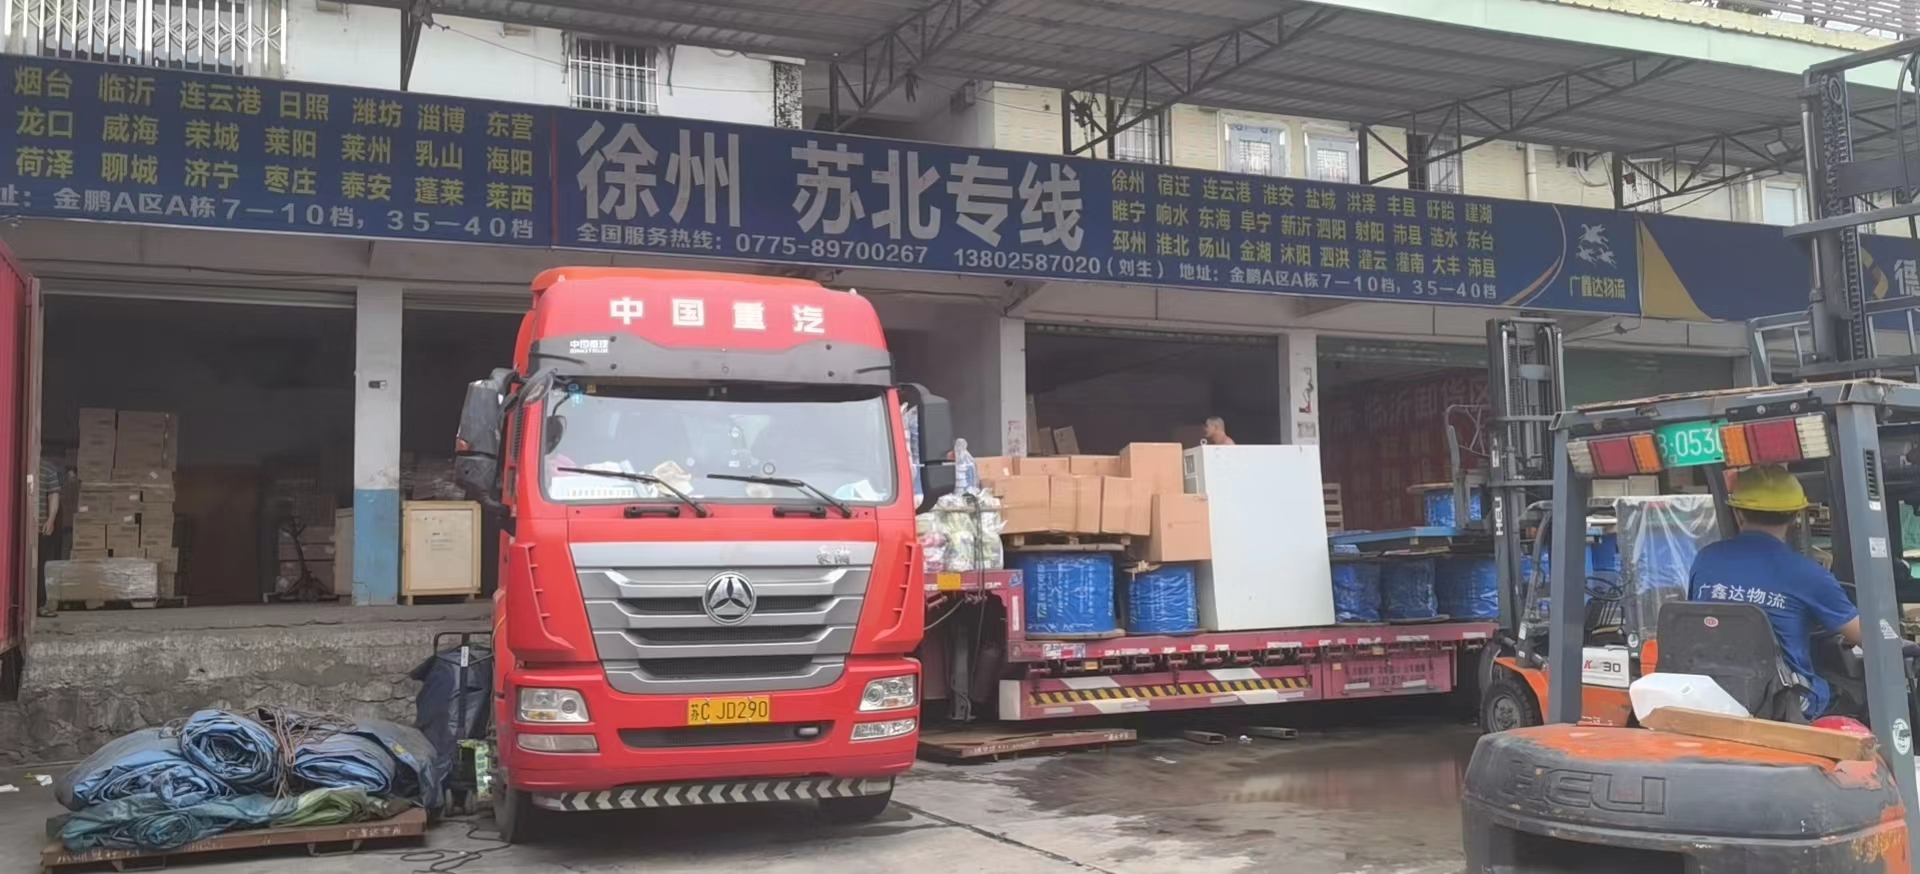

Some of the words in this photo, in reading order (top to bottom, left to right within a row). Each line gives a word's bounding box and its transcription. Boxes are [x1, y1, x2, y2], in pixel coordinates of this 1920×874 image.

[15, 66, 73, 99] 烟台
[98, 72, 156, 106] 临沂
[180, 80, 262, 115] 连云港
[280, 90, 329, 121] 日照
[352, 97, 403, 128] 潍坊
[417, 104, 466, 134] 淄博
[486, 112, 534, 141] 东营
[16, 105, 73, 138] 龙口
[103, 113, 159, 145] 威海
[185, 119, 239, 152] 荣城
[264, 126, 317, 158] 莱阳
[341, 133, 391, 164] 莱州
[415, 140, 463, 170] 乳山
[486, 146, 533, 176] 海阳
[102, 152, 158, 185] 聊城
[184, 158, 239, 190] 济宁
[264, 164, 317, 195] 枣庄
[341, 171, 392, 201] 泰安
[414, 176, 464, 207] 蓬莱
[486, 182, 534, 212] 莱西
[577, 120, 740, 228] 徐州
[791, 140, 1085, 251] 苏北专线
[1111, 169, 1145, 193] 徐州
[1158, 173, 1191, 197] 宿迁
[1202, 177, 1251, 203] 连云港
[1263, 184, 1294, 207] 淮安
[1305, 188, 1336, 211] 盐城
[1347, 192, 1376, 214] 洪泽
[1387, 195, 1416, 217] 丰县
[1112, 200, 1145, 223] 睢宁
[1156, 203, 1189, 227] 响水
[1199, 206, 1231, 230] 东海
[1240, 210, 1271, 233] 阜宁
[1281, 214, 1312, 237] 新沂
[1316, 218, 1346, 240] 泗阳
[1355, 220, 1384, 242] 射阳
[1466, 230, 1494, 251] 东台
[1156, 232, 1189, 257] 淮北
[1240, 240, 1271, 263] 金湖
[1320, 246, 1350, 269] 泗洪
[1358, 249, 1387, 271] 灌云
[1432, 254, 1460, 276] 大丰
[1697, 583, 1787, 609] 广鑫达物流
[1602, 661, 1621, 673] 30
